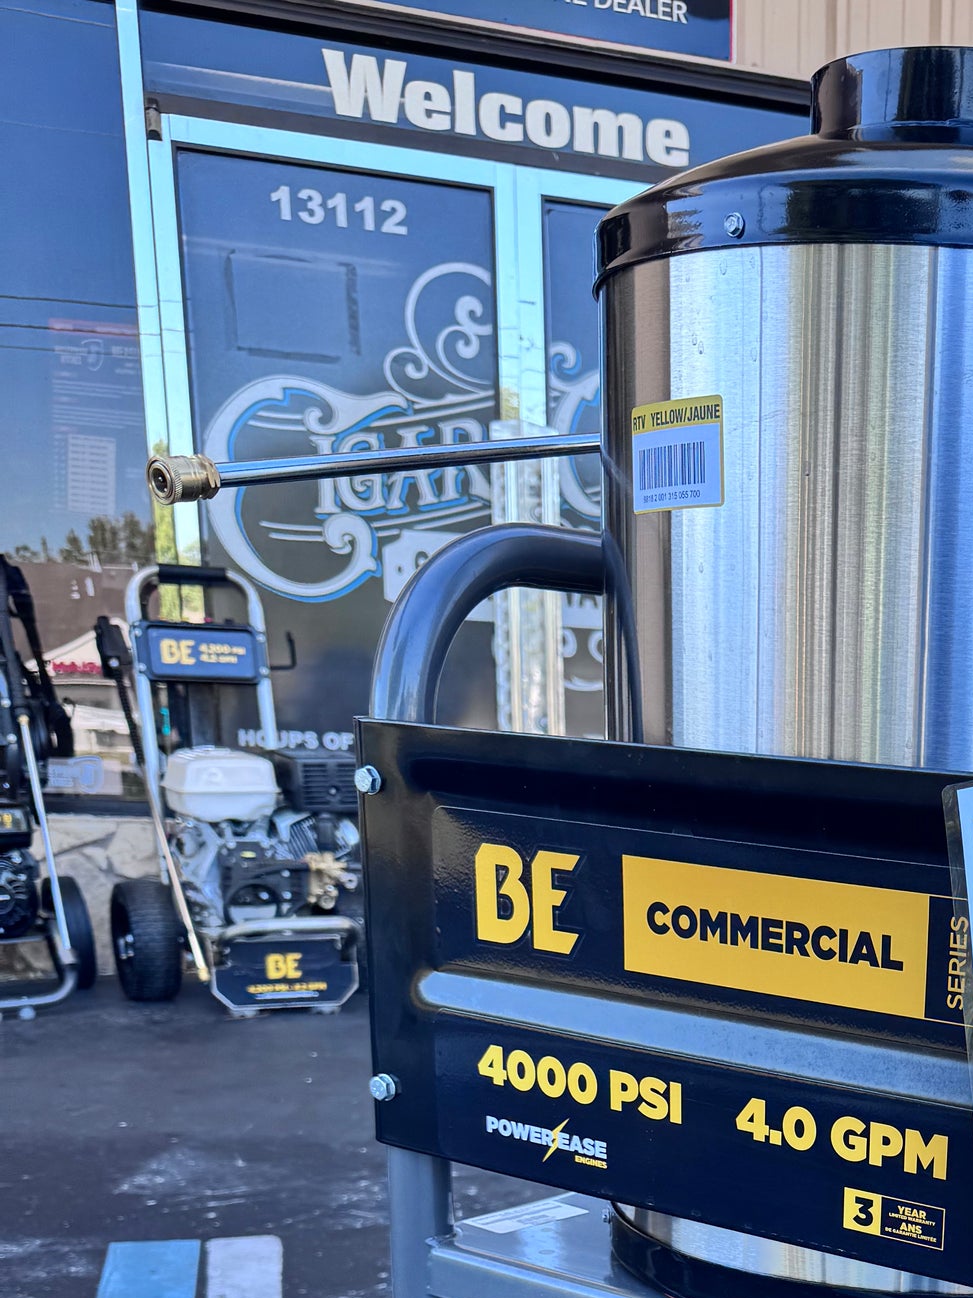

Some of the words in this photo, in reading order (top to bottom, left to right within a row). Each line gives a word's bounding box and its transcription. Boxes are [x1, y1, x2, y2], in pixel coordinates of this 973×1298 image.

[321, 48, 690, 168] Welcome
[270, 186, 408, 235] 13112
[632, 414, 646, 432] RTV
[650, 403, 720, 427] YELLOW/JAUNE
[160, 638, 196, 665] BE
[475, 843, 580, 955] BE
[646, 901, 904, 972] COMMERCIAL
[265, 952, 302, 979] BE
[946, 916, 969, 1011] SERIES
[477, 1044, 598, 1105] 4000
[609, 1069, 683, 1124] PSI
[486, 1115, 608, 1160] POWEREASE
[735, 1097, 817, 1151] 4.0
[830, 1115, 949, 1180] GPM
[574, 1155, 608, 1170] ENGINES
[853, 1196, 874, 1227] 3
[888, 1212, 908, 1221] LIMITED
[907, 1216, 936, 1227] WARRANTY
[897, 1205, 927, 1220] YEAR
[899, 1222, 922, 1235] ANS
